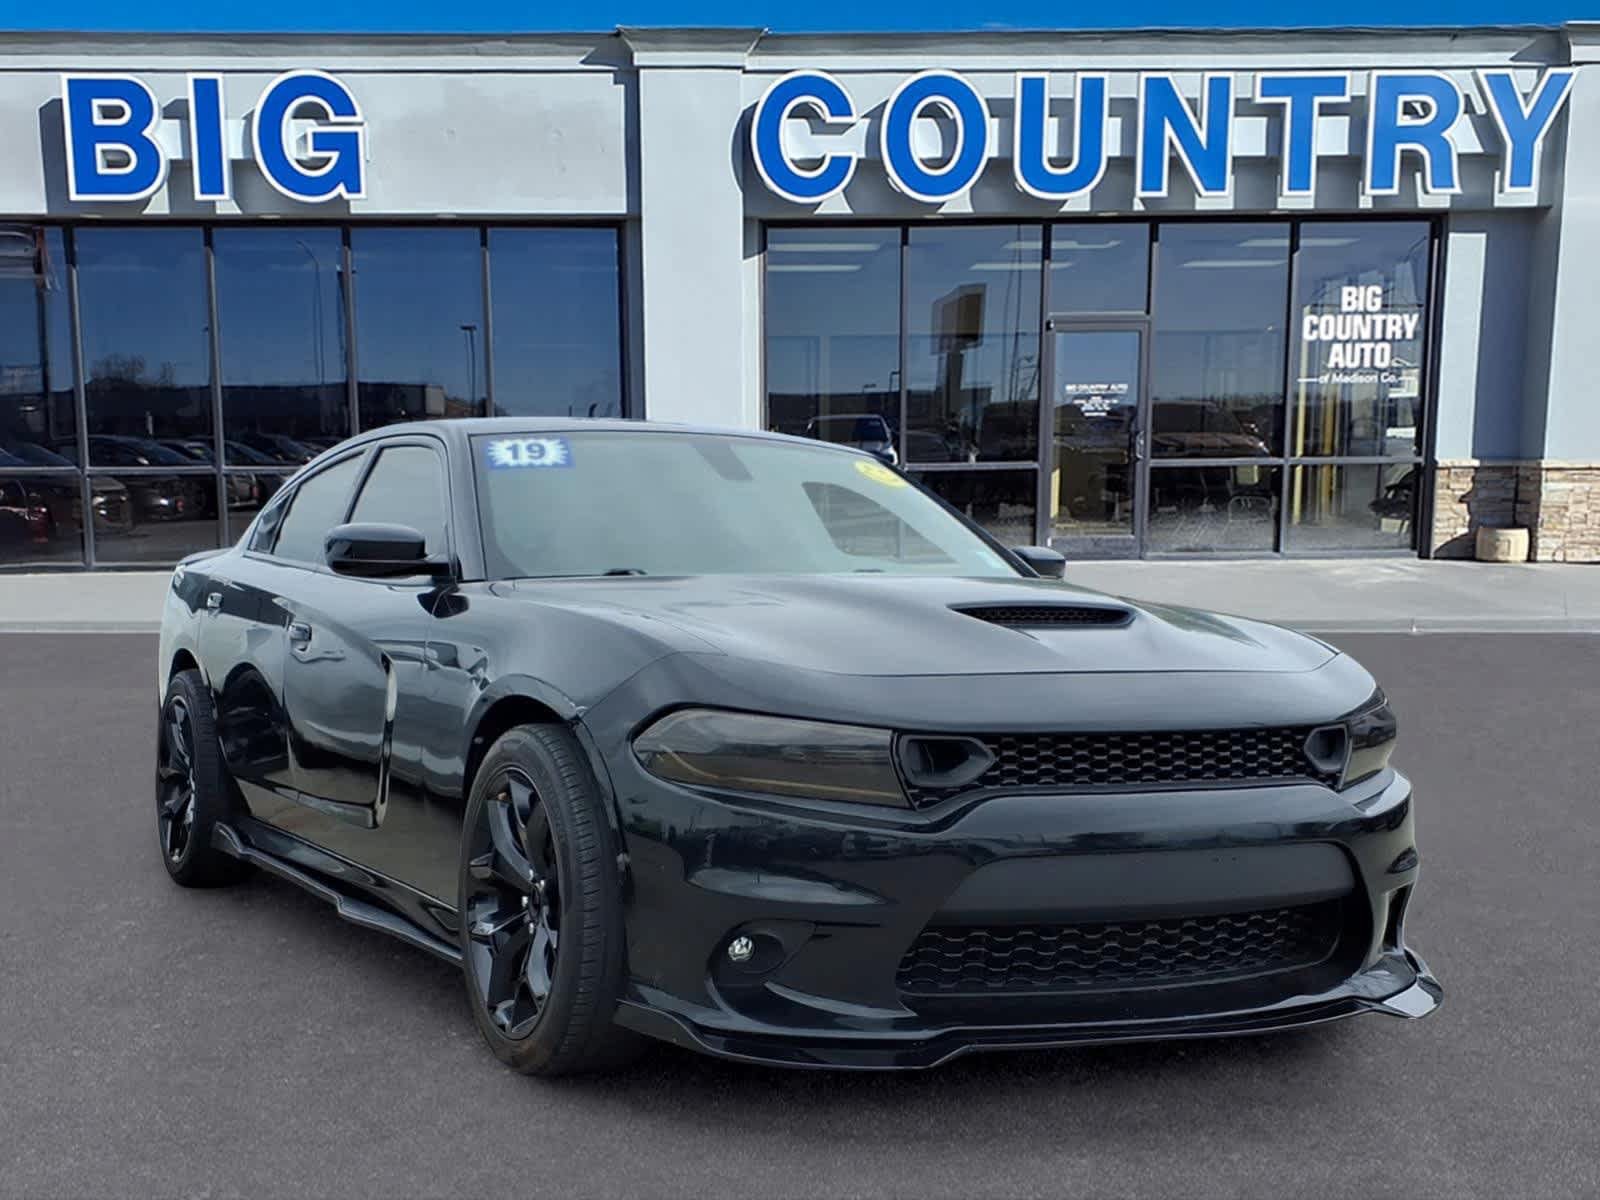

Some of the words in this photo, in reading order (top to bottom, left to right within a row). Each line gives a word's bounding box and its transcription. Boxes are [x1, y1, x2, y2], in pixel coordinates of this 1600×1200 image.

[60, 69, 367, 202] BIG
[751, 69, 1577, 203] COUNTRY
[1341, 285, 1382, 313] BIG
[1303, 314, 1419, 341] COUNTRY
[1328, 342, 1391, 369] AUTO
[1319, 372, 1331, 384] of
[1331, 372, 1378, 384] Madison
[506, 442, 546, 461] 19
